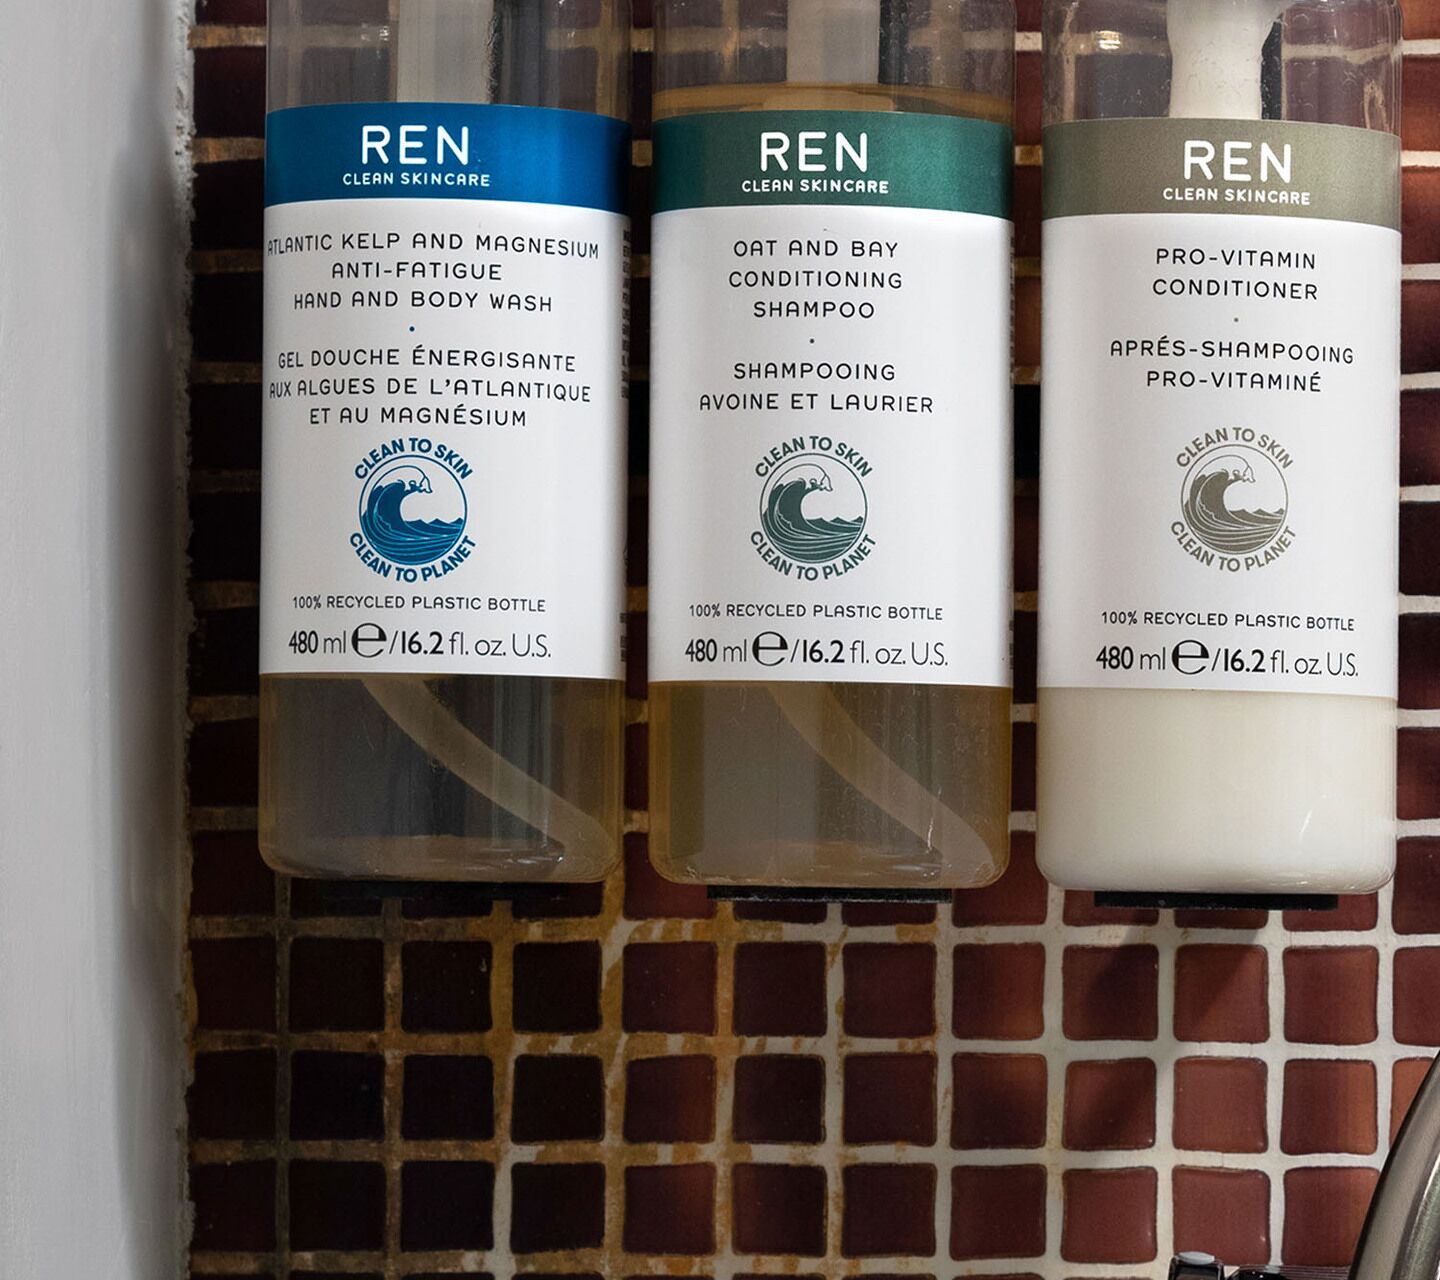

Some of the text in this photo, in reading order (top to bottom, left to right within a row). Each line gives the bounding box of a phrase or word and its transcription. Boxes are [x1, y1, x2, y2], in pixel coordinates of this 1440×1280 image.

[361, 124, 469, 166] REN
[760, 131, 868, 173] REN
[1183, 140, 1292, 184] REN
[342, 172, 490, 187] CLEAN SKINCARE
[741, 178, 889, 194] CLEAN SKINCARE
[1162, 187, 1311, 206] CLEAN SKINCARE
[268, 232, 599, 259] ATLANTIC KELP AND MAGNESIUM
[733, 239, 898, 258] OAT AND BAY
[1156, 248, 1315, 270] PRO-VITAMIN
[332, 261, 502, 281] ANTI-FATIGUE
[728, 270, 902, 290] CONDITIONING
[1152, 278, 1318, 301] CONDITIONER
[294, 290, 552, 313] HAND AND BODY WASH
[753, 300, 875, 319] SHAMPOO
[278, 344, 576, 373] GEL DOUCHE ÉNERGISANTE
[1110, 335, 1354, 365] APRÉS-SHAMPOOING
[733, 362, 895, 381] SHAMPOOING
[1147, 370, 1321, 393] PRO-VITAMINÉ
[269, 381, 292, 398] AUX
[297, 377, 375, 396] ALGUES
[387, 377, 418, 395] DE
[310, 403, 526, 427] ET AU MAGNÉSIUM
[699, 393, 933, 414] AVOINE ET LAURIER
[354, 437, 474, 480] CLEAN TO SKIN
[755, 435, 873, 478] CLEAN TO SKIN
[1176, 426, 1294, 470] CLEAN TO SKIN
[349, 531, 477, 585] CLEAN TO PLANET
[750, 530, 877, 582] CLEAN TO PLANET
[1170, 521, 1296, 573] CLEAN TO PLANET
[292, 594, 546, 613] 100% RECYCLED PLASTIC BOTTLE
[689, 602, 943, 621] 100% RECYCLED PLASTIC BOTTLE
[1101, 610, 1355, 632] 100% RECYCLED PLASTIC BOTTLE
[288, 630, 319, 654] 480
[323, 630, 347, 654] ml
[448, 631, 469, 656] fl.
[474, 639, 507, 657] oz.
[512, 633, 552, 658] U.S.
[684, 638, 718, 663] 480
[722, 638, 747, 663] ml
[849, 639, 870, 664] fl.
[875, 647, 906, 665] oz.
[911, 641, 949, 666] U.S.
[1095, 645, 1134, 670] 480
[1139, 646, 1166, 671] ml
[1269, 649, 1289, 674] fl.
[1294, 657, 1323, 675] oz.
[1326, 651, 1359, 677] U.S.
